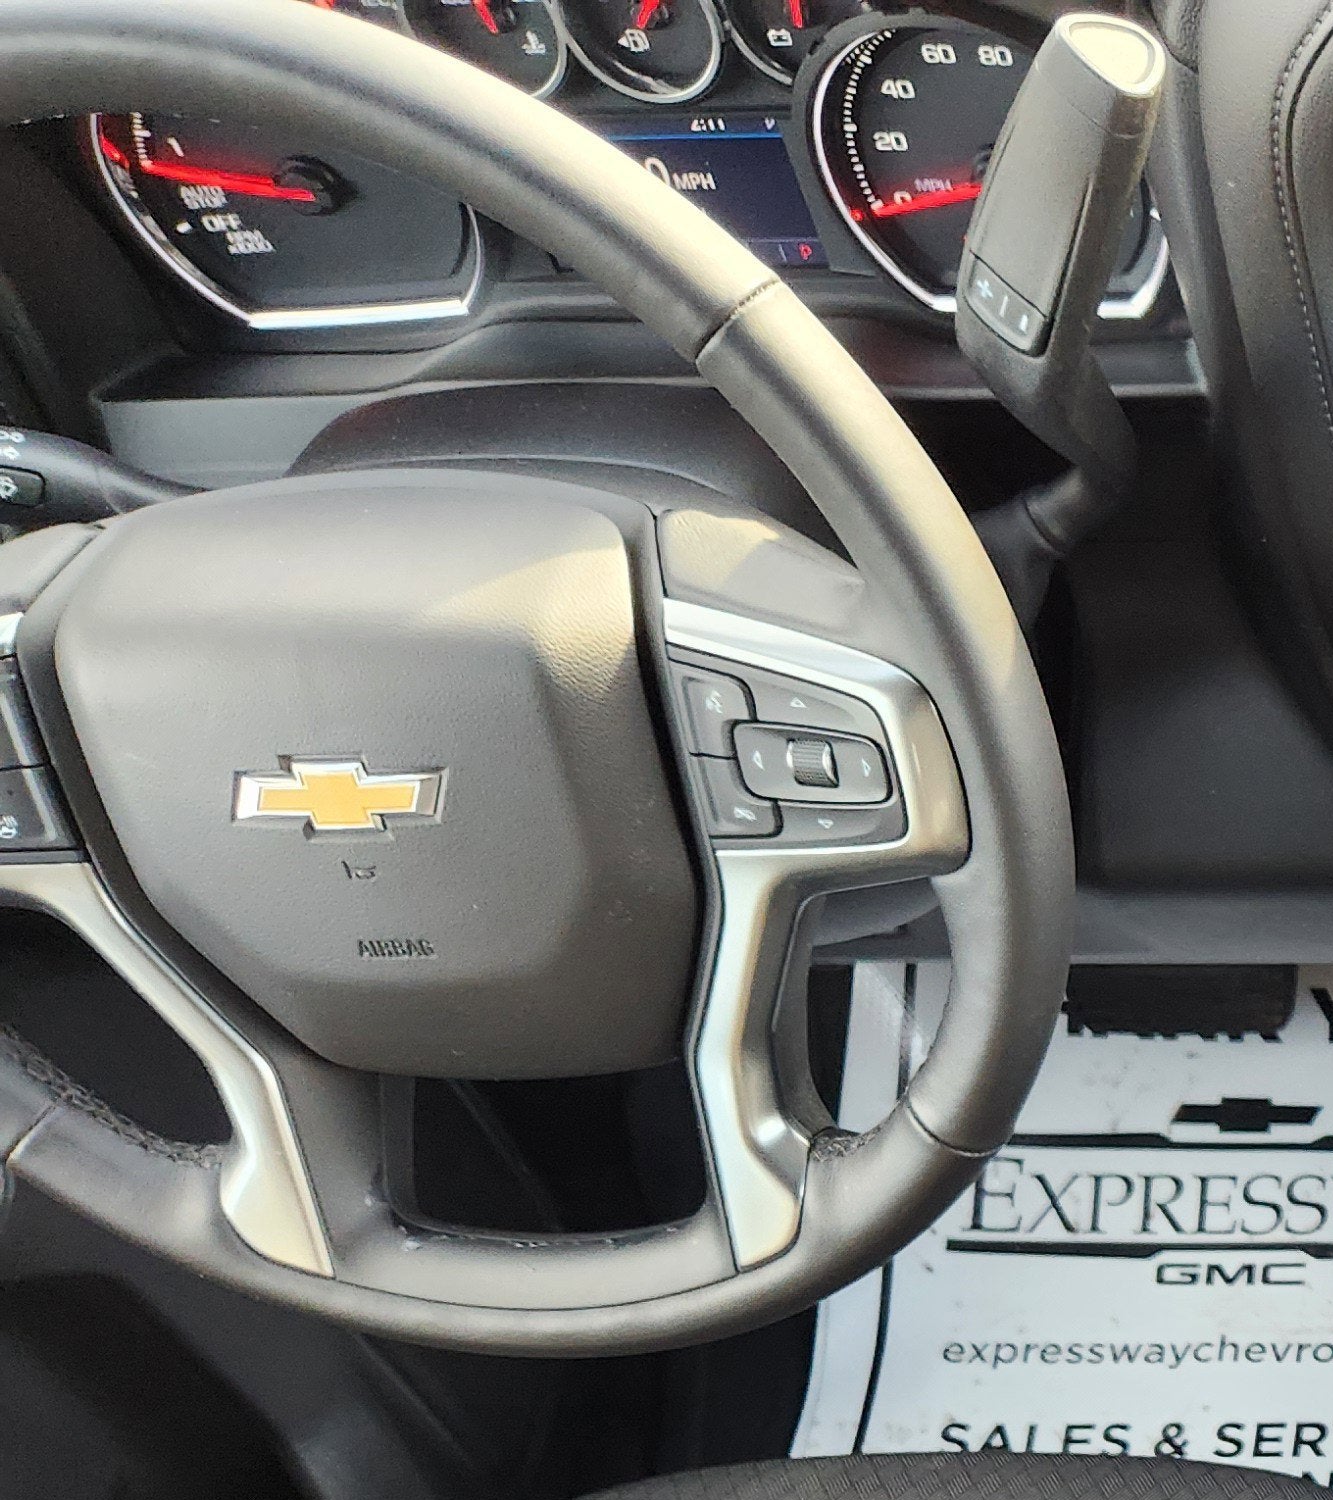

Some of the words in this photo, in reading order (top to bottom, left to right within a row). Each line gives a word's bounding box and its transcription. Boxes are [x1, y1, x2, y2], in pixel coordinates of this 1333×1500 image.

[921, 43, 956, 64] 60
[978, 44, 1013, 67] 80
[880, 77, 916, 99] 40
[873, 130, 909, 152] 20
[672, 172, 717, 190] MPH
[357, 938, 436, 958] AIRBAG
[1155, 1262, 1307, 1286] GMC
[938, 1422, 1132, 1457] SALES
[1153, 1422, 1190, 1459] &
